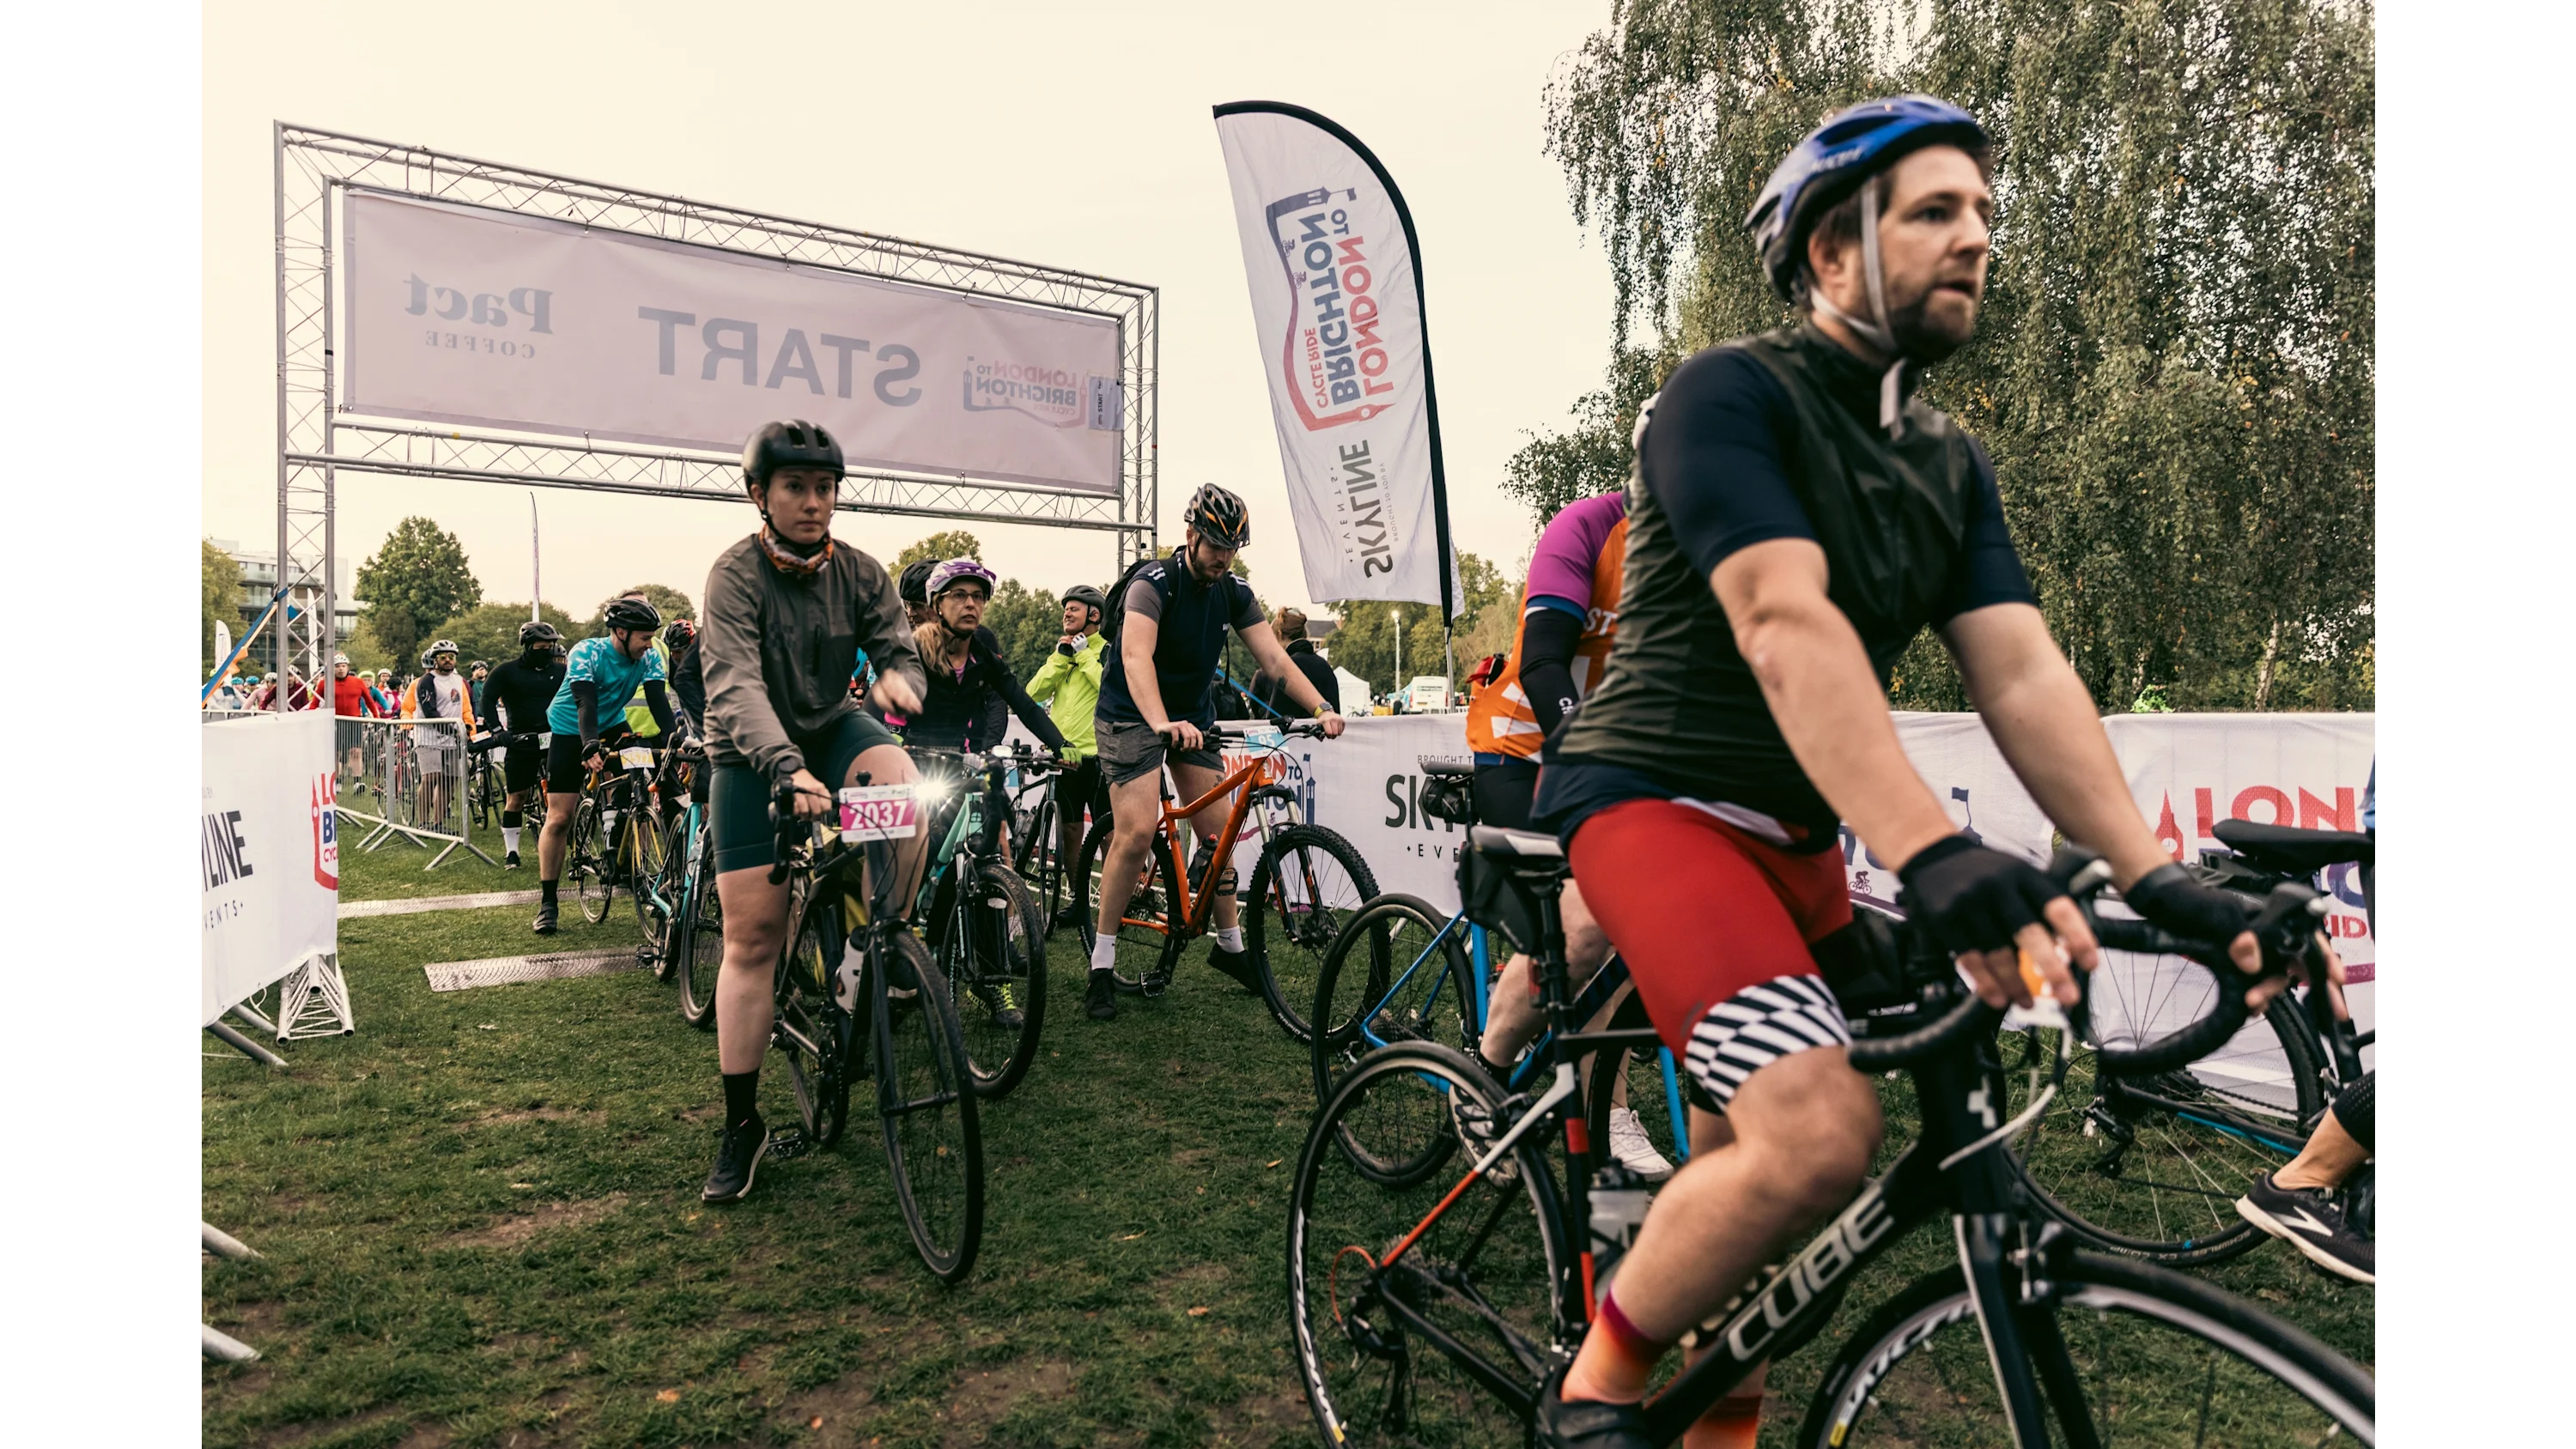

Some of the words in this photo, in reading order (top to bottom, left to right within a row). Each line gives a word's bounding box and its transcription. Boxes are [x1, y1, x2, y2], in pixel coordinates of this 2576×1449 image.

[1258, 734, 1276, 749] 95
[1288, 766, 1303, 780] TO
[848, 801, 908, 830] 2037
[2195, 785, 2366, 839] LON
[1728, 1199, 1894, 1362] CUBE
